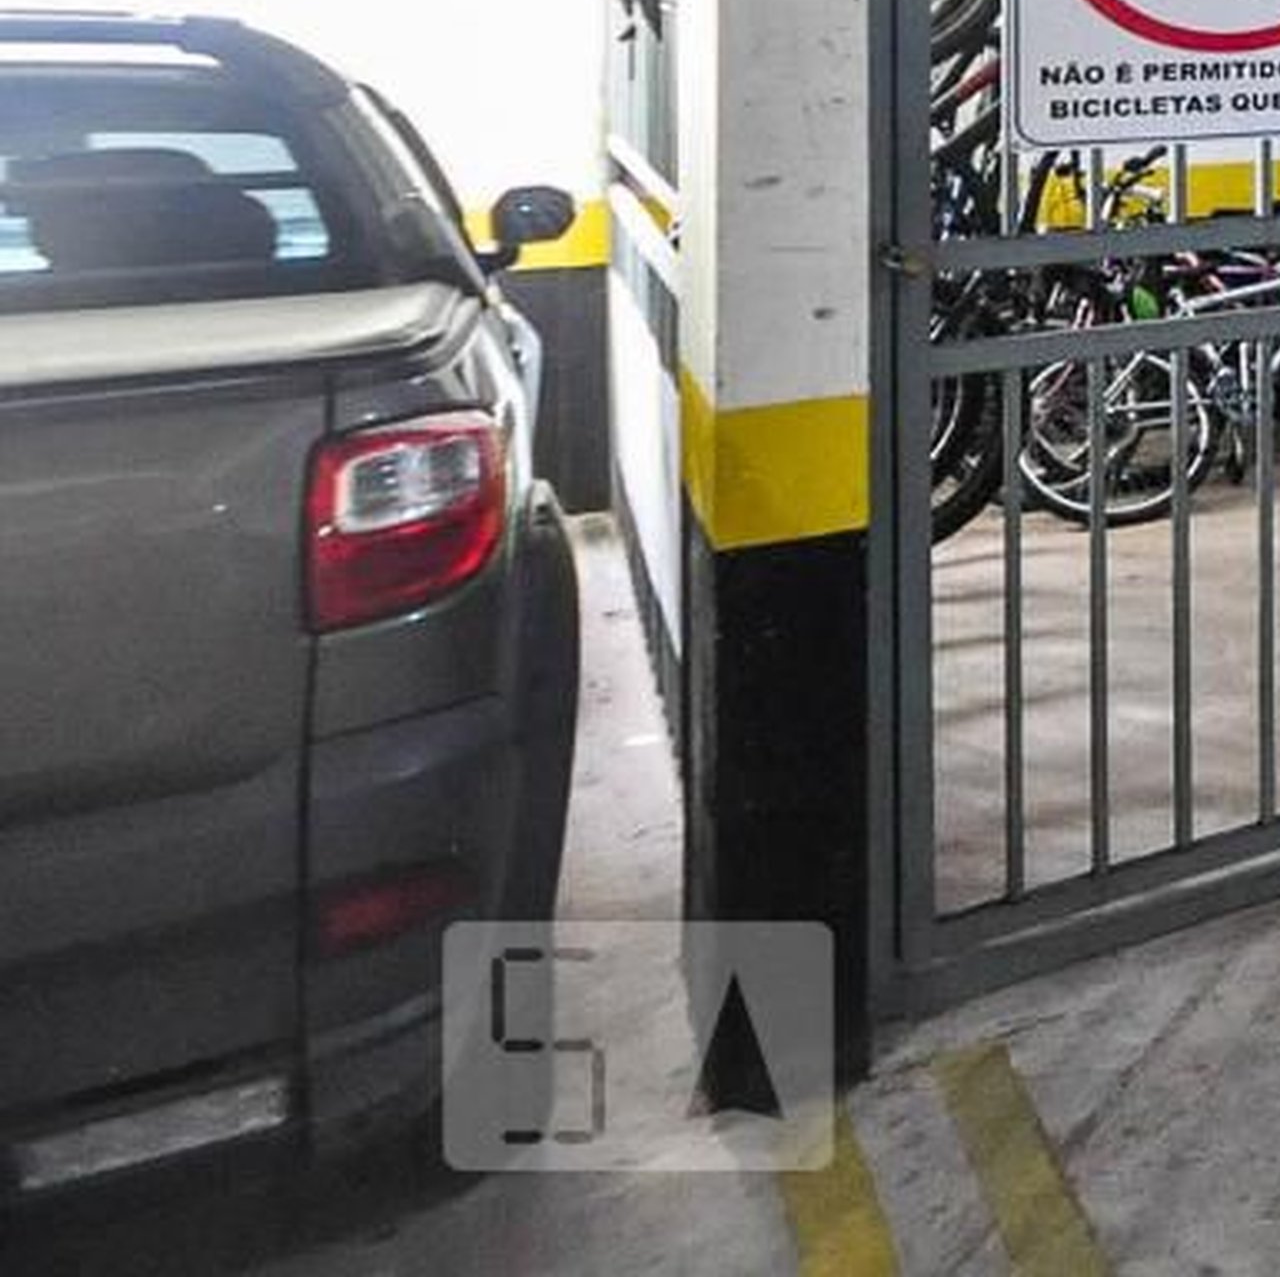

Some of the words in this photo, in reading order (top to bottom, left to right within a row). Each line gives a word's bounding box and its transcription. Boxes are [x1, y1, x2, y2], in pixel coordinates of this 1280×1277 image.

[1039, 61, 1105, 86] NÃO
[1115, 61, 1134, 84] É
[1050, 93, 1222, 120] BICICLETAS
